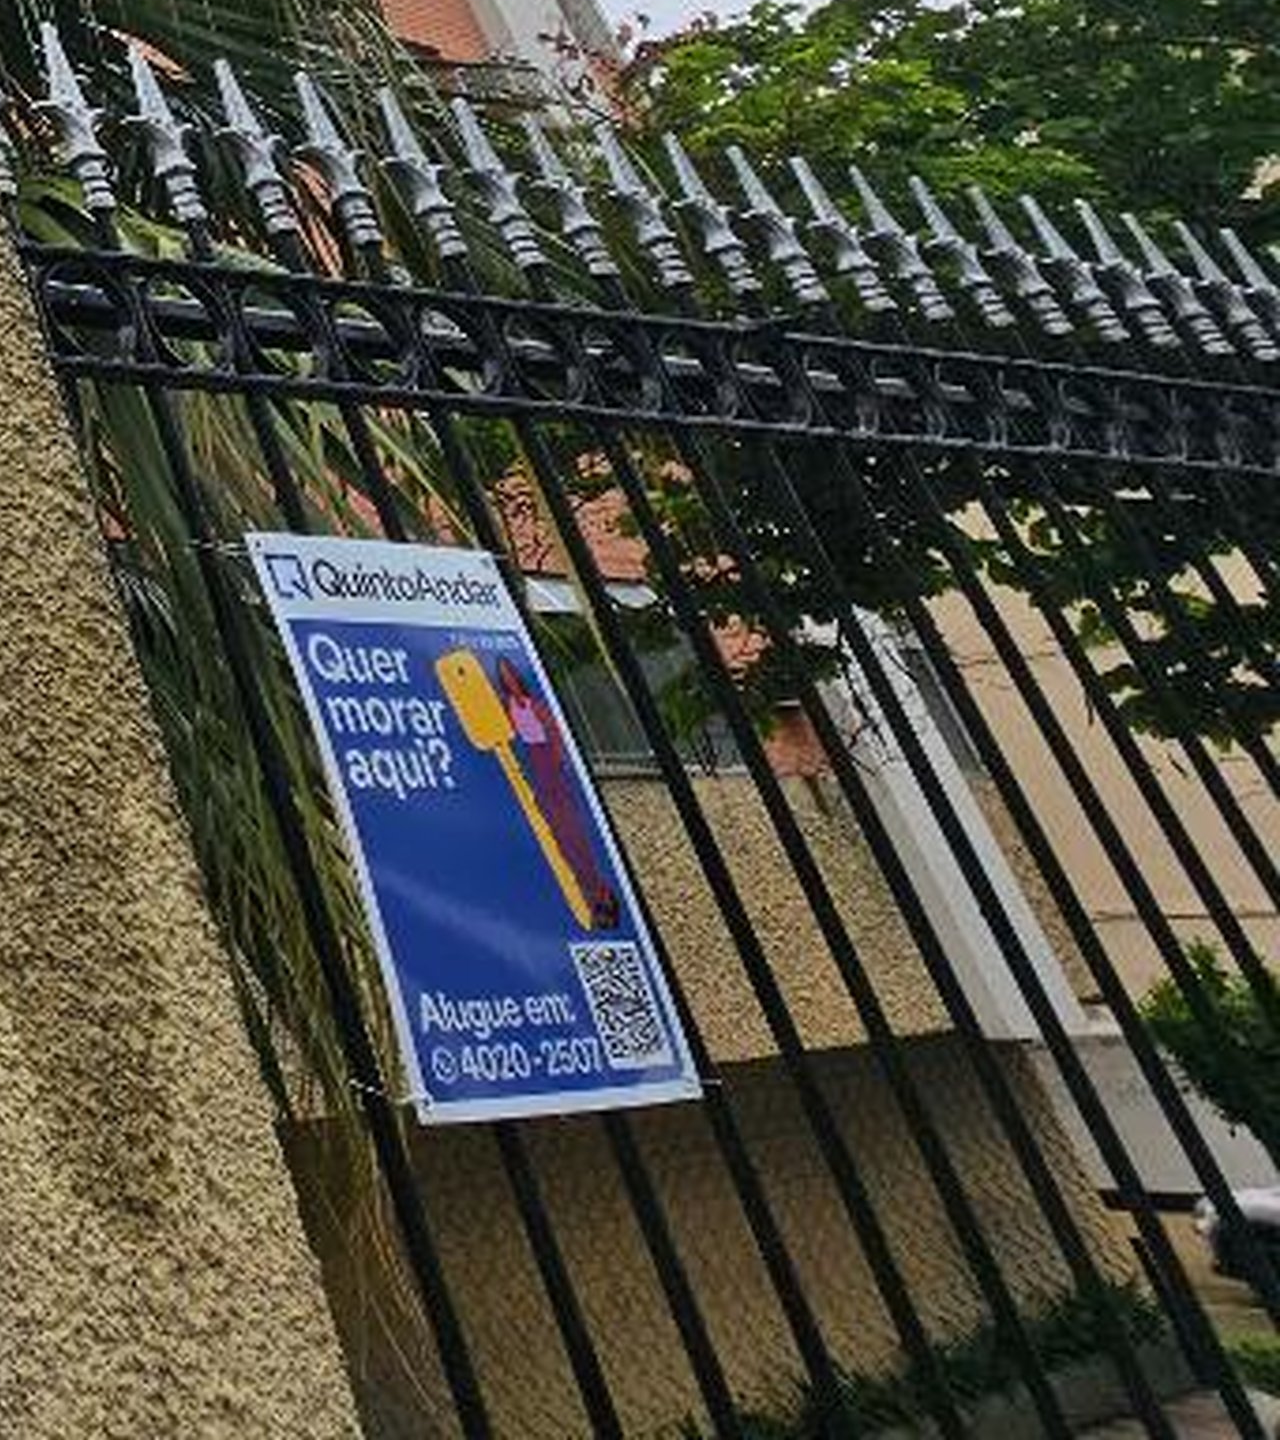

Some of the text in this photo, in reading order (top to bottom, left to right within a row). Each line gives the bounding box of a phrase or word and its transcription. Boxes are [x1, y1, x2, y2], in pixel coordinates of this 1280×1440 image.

[311, 559, 502, 609] QuintoAndar
[307, 632, 410, 684] Quer
[326, 696, 447, 737] morar
[345, 736, 456, 801] aqui?
[420, 991, 577, 1040] Alugue em:
